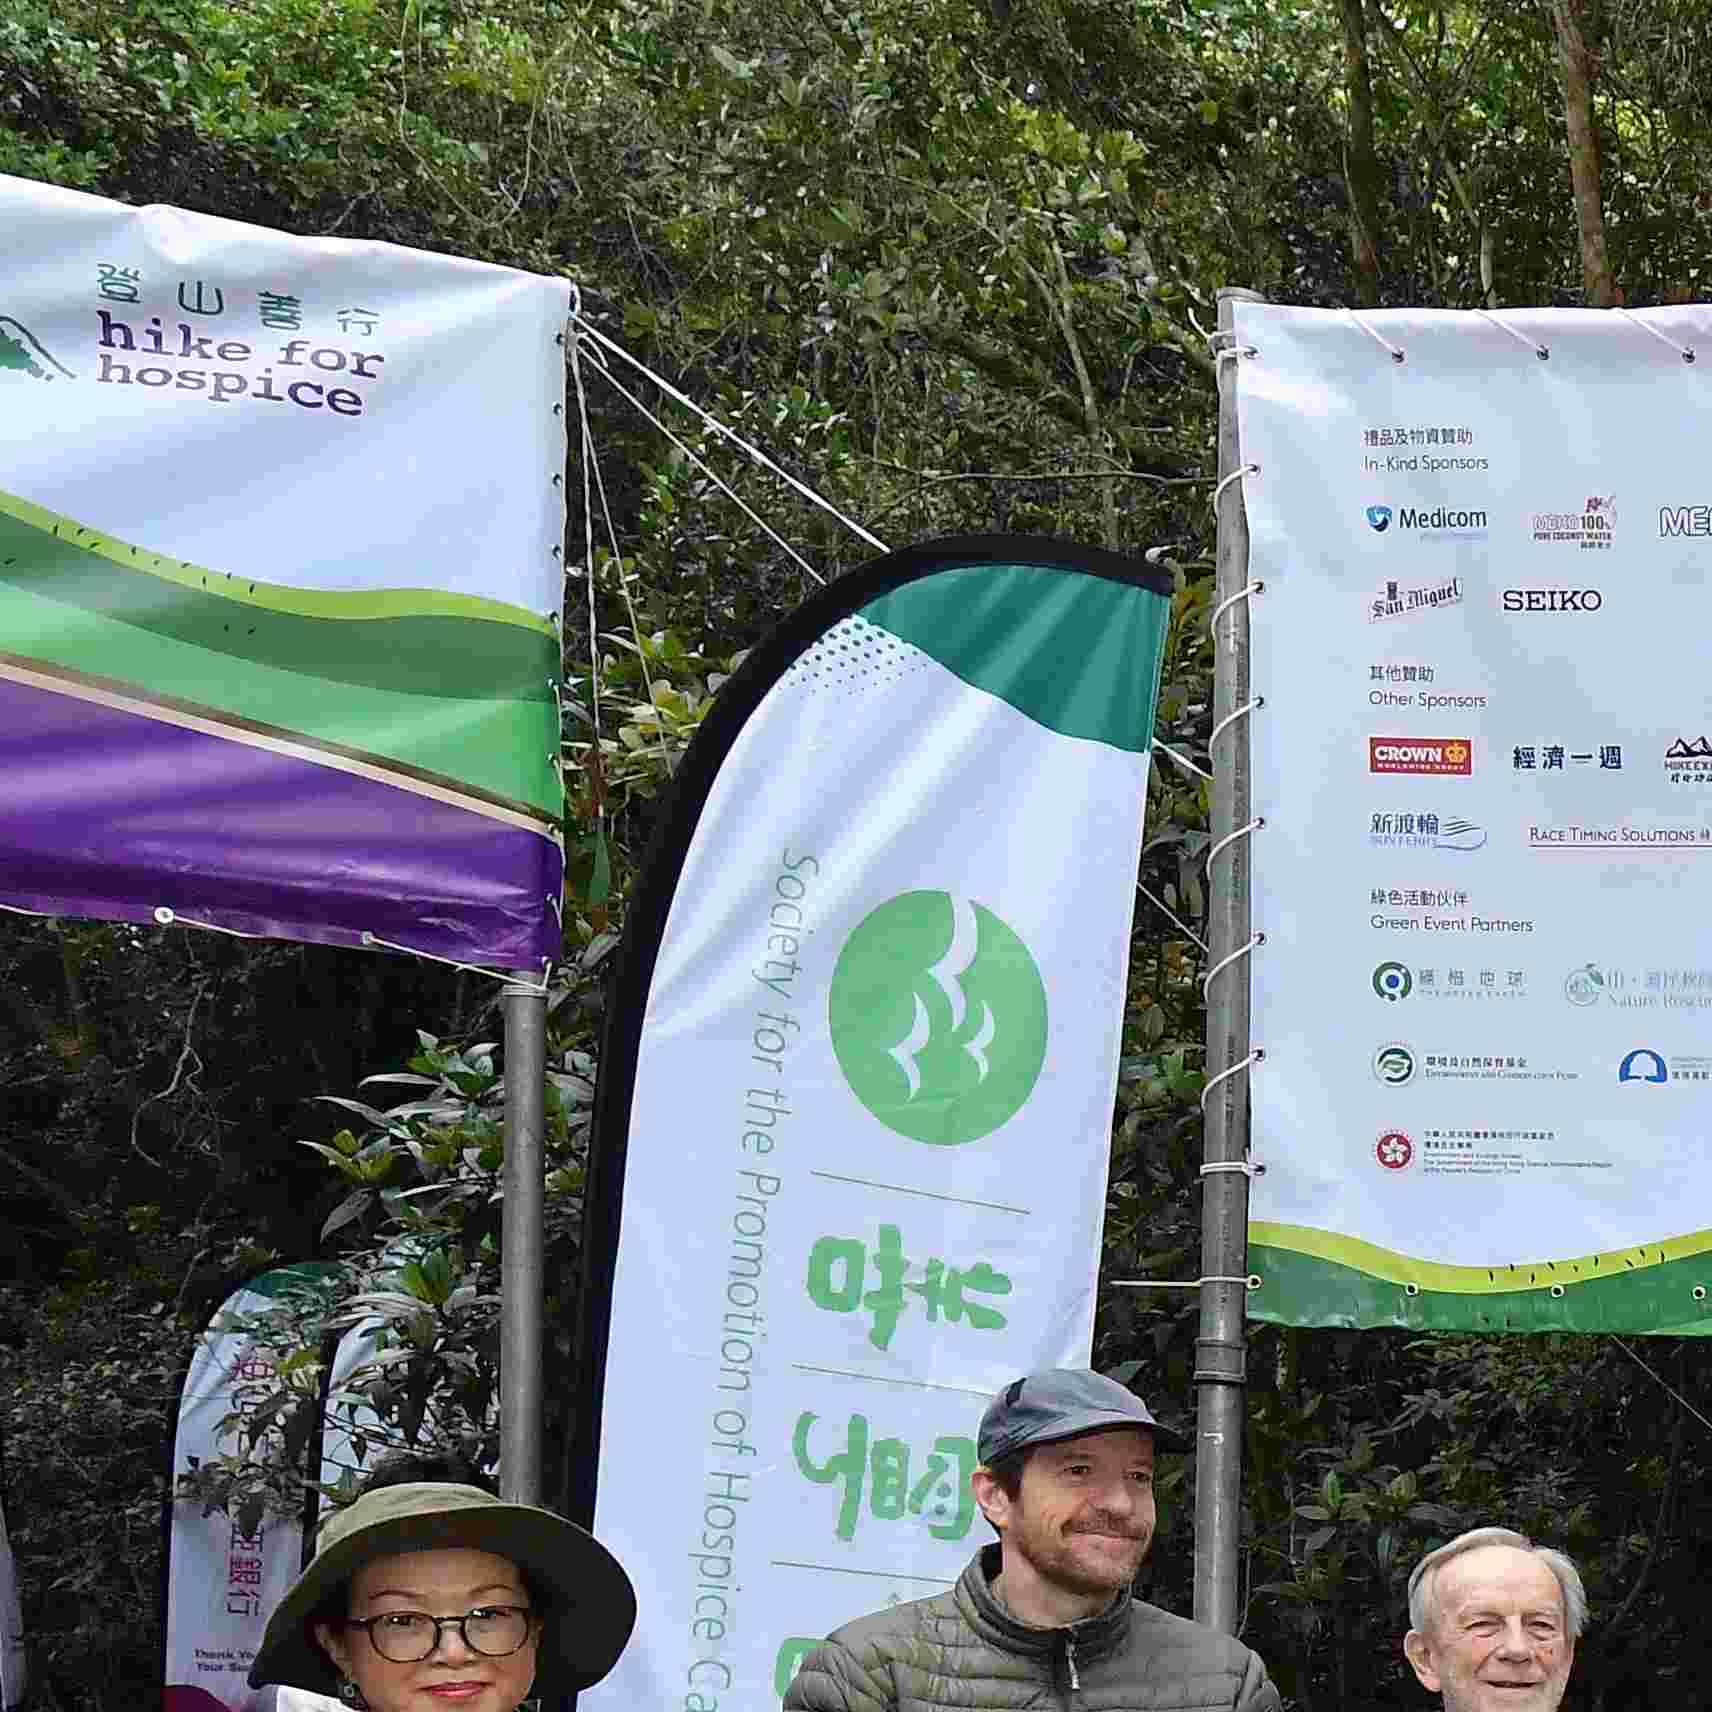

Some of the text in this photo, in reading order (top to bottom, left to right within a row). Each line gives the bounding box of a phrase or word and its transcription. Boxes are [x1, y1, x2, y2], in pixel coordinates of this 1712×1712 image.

[97, 262, 382, 337] 登山善行
[97, 309, 385, 379] hike for
[97, 354, 364, 416] hospice
[1364, 455, 1489, 473] In-Kind Sponsors
[1399, 507, 1488, 529] Medicom
[1406, 577, 1463, 610] Miguel
[1502, 590, 1602, 611] SEIKO
[1369, 690, 1487, 710] Other Sponsors
[1374, 745, 1442, 762] CROWN
[1512, 745, 1622, 770] 經濟一週
[1370, 813, 1440, 835] 新渡輪
[1529, 827, 1565, 842] RACE
[1568, 827, 1617, 842] TIMING
[1620, 827, 1696, 842] SOLUTIONS
[750, 850, 820, 996] Society
[1370, 914, 1535, 933] Green Event Partners
[750, 1020, 802, 1092] for
[738, 1089, 792, 1155] the
[717, 1169, 782, 1392] Promotion
[713, 1409, 758, 1457] of
[687, 1470, 753, 1643] Hospice
